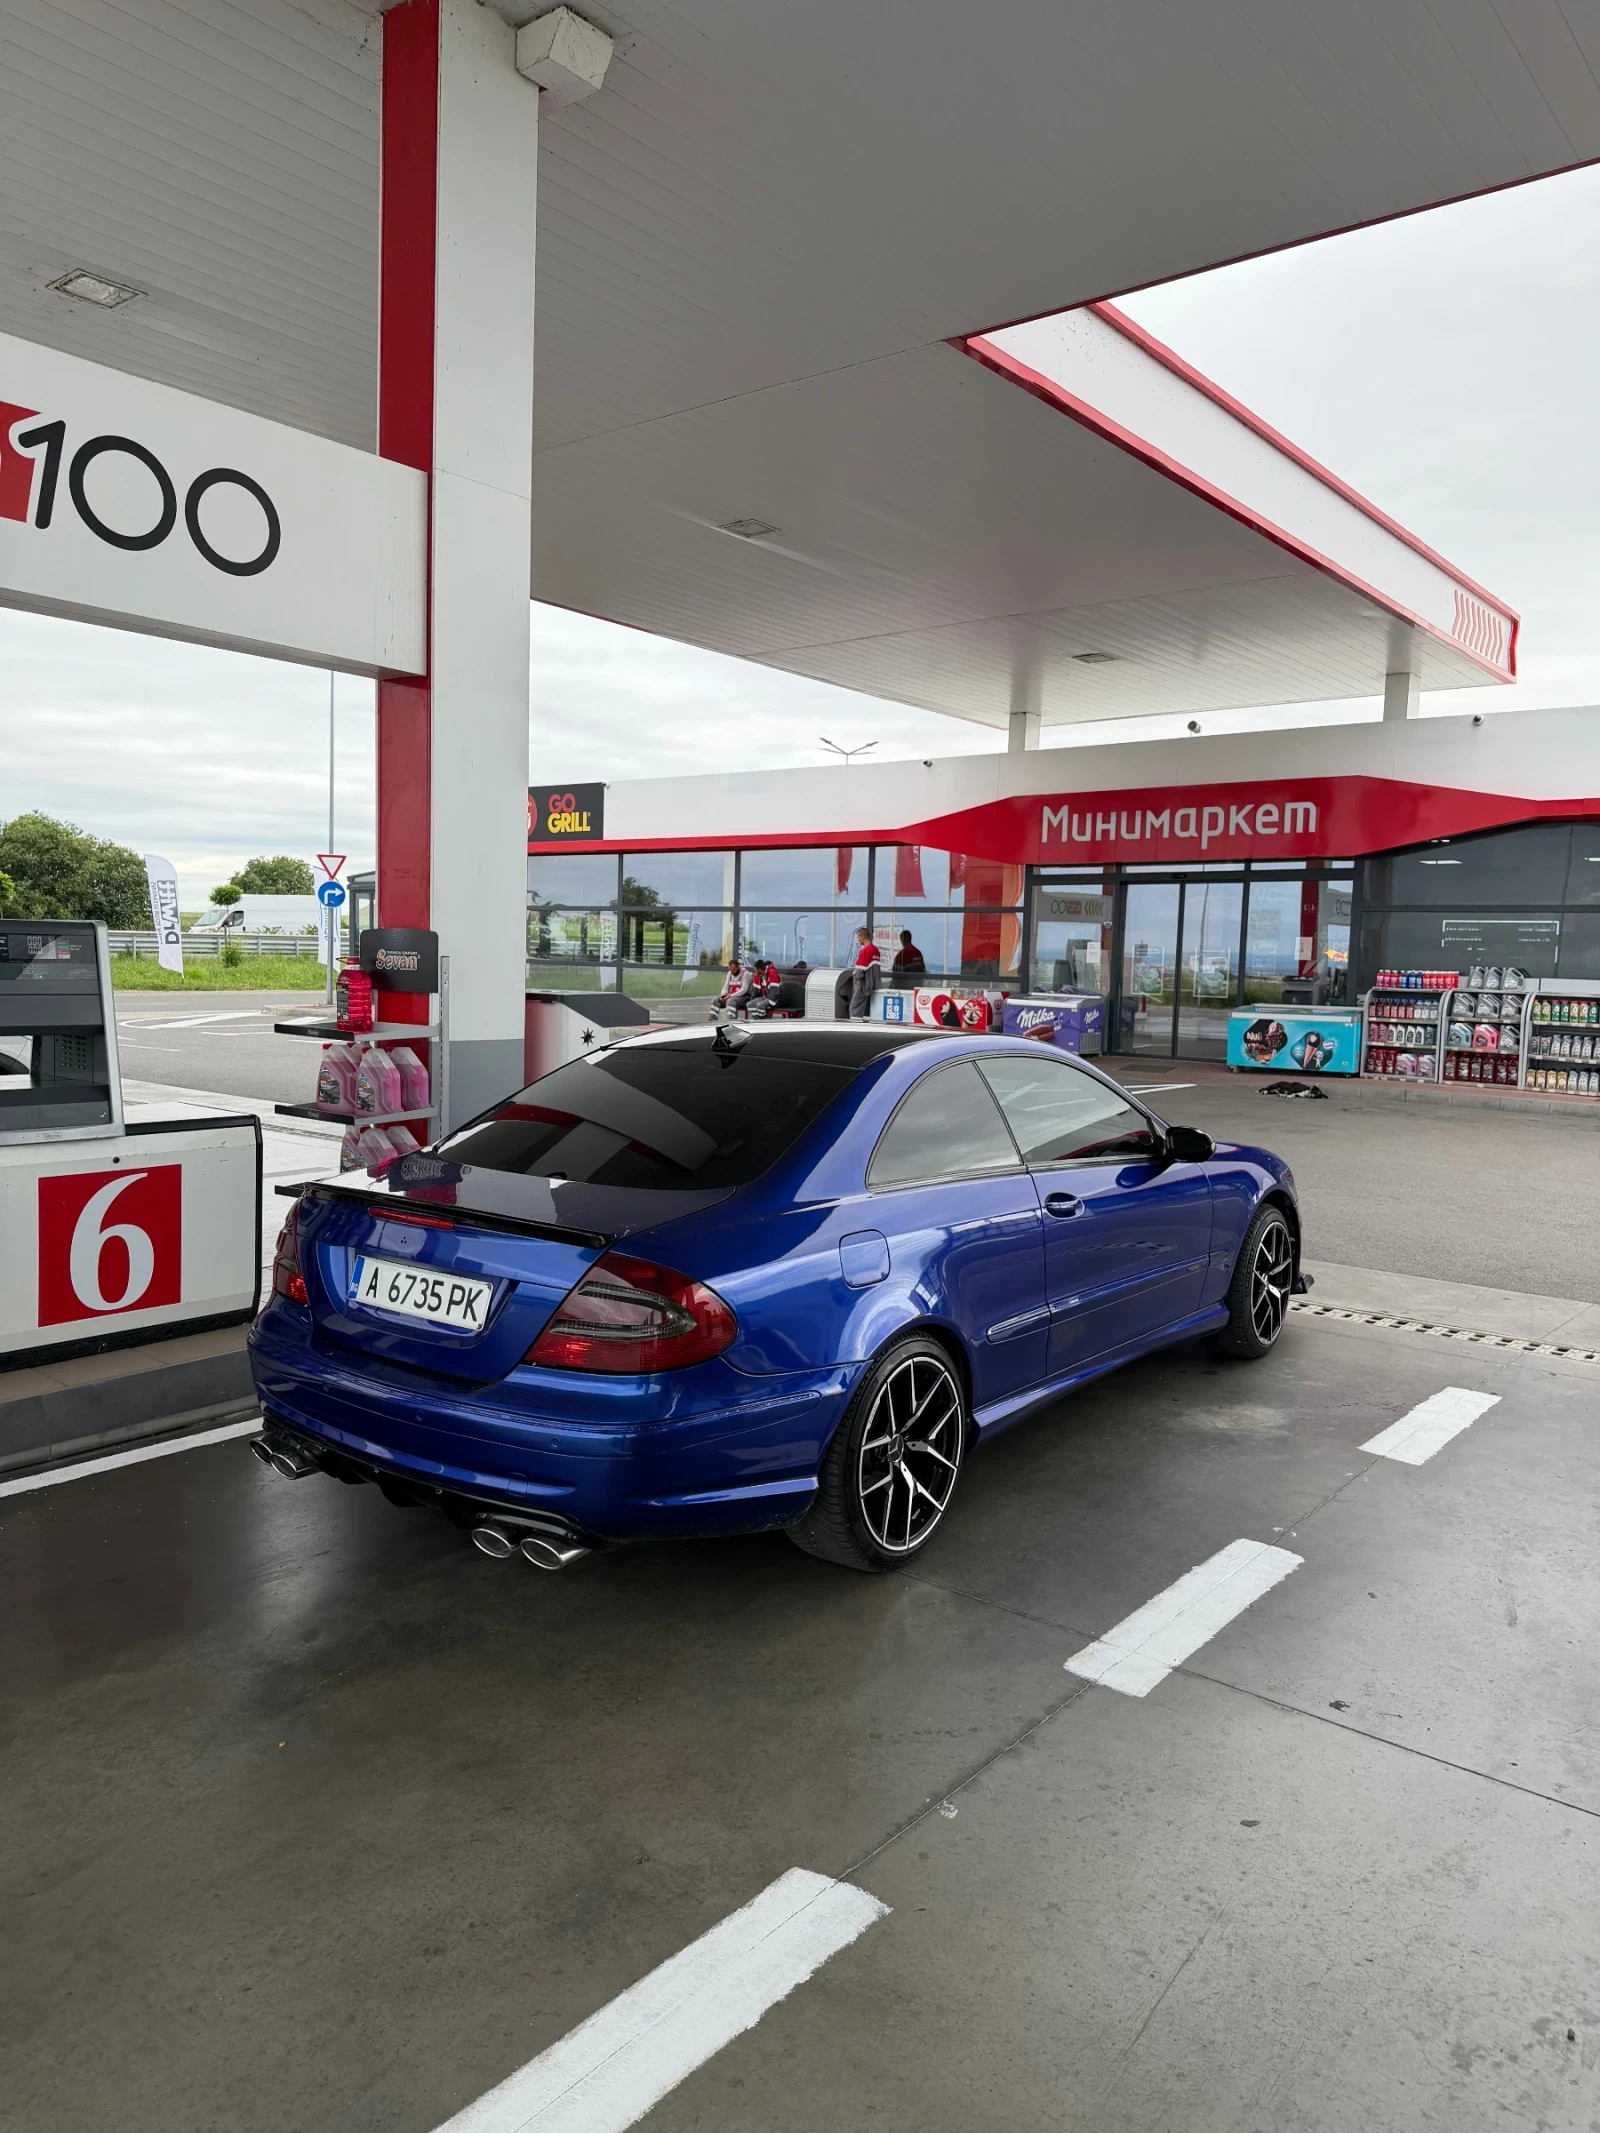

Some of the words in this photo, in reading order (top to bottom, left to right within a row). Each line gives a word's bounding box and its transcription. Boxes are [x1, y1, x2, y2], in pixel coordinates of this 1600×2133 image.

[17, 420, 281, 576] 100
[548, 793, 576, 813] GO
[547, 811, 591, 834] GRILL
[1041, 801, 1318, 850] Минимаркет
[375, 948, 418, 971] Sevan
[1016, 1007, 1055, 1028] Milka
[70, 1172, 155, 1311] 6
